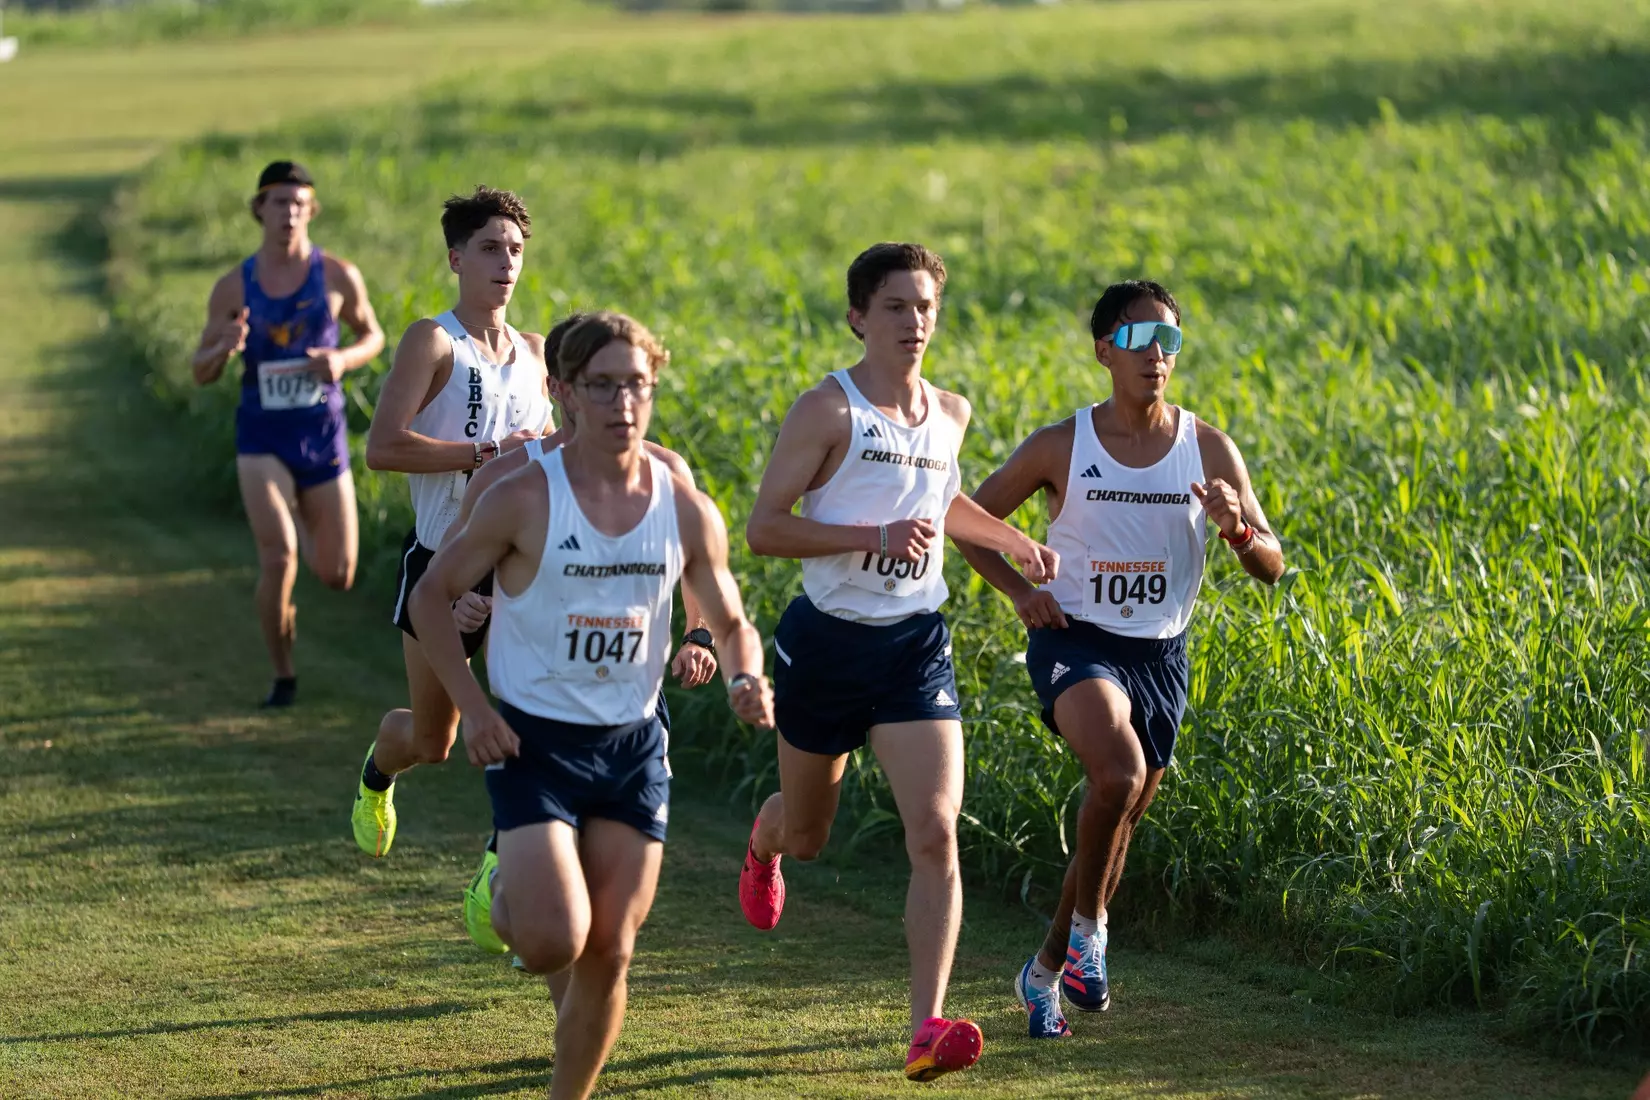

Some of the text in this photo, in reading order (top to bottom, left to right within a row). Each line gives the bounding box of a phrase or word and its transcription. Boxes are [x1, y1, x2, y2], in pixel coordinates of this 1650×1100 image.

[464, 366, 482, 438] BBTC
[1086, 489, 1191, 505] CHATTANOOGA
[1090, 560, 1167, 573] TENNESSEE
[1089, 574, 1167, 605] 1049
[567, 614, 643, 629] TENNESSEE
[564, 629, 644, 664] 1047
